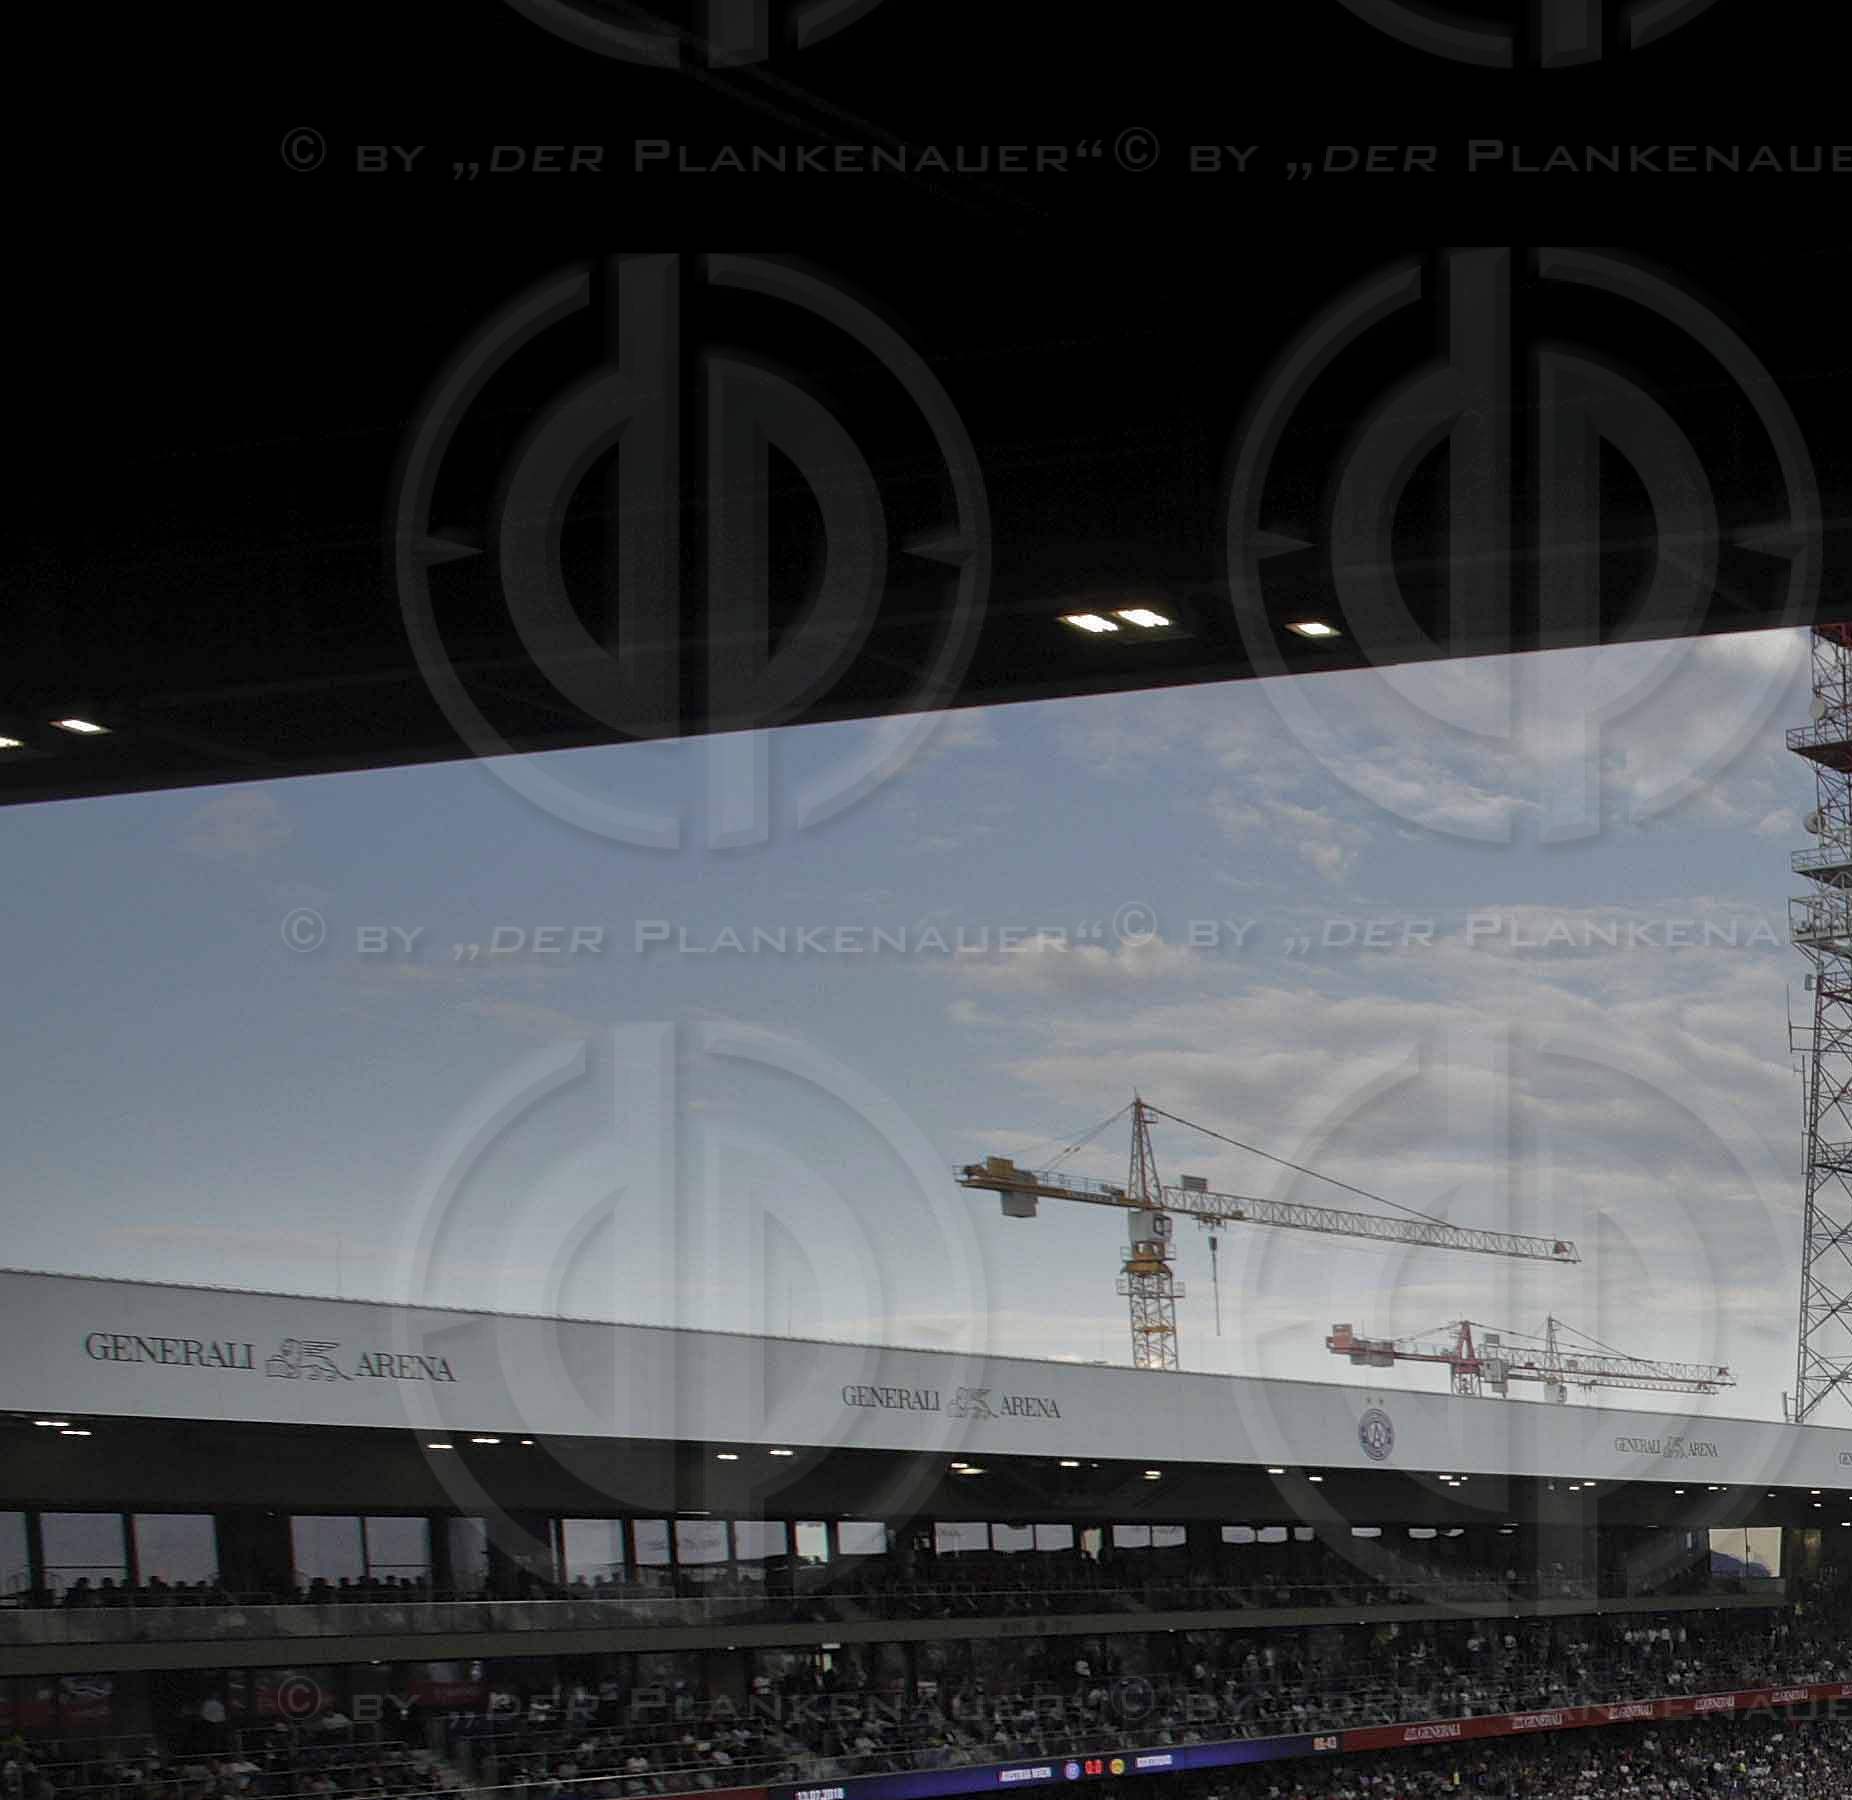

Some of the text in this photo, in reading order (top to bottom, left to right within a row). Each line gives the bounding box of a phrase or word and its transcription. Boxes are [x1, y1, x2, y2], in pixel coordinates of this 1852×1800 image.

[85, 1333, 456, 1382] GENERALI ARENA
[842, 1385, 1061, 1418] GENERALI ARENA
[1415, 1723, 1462, 1742] GENERALI
